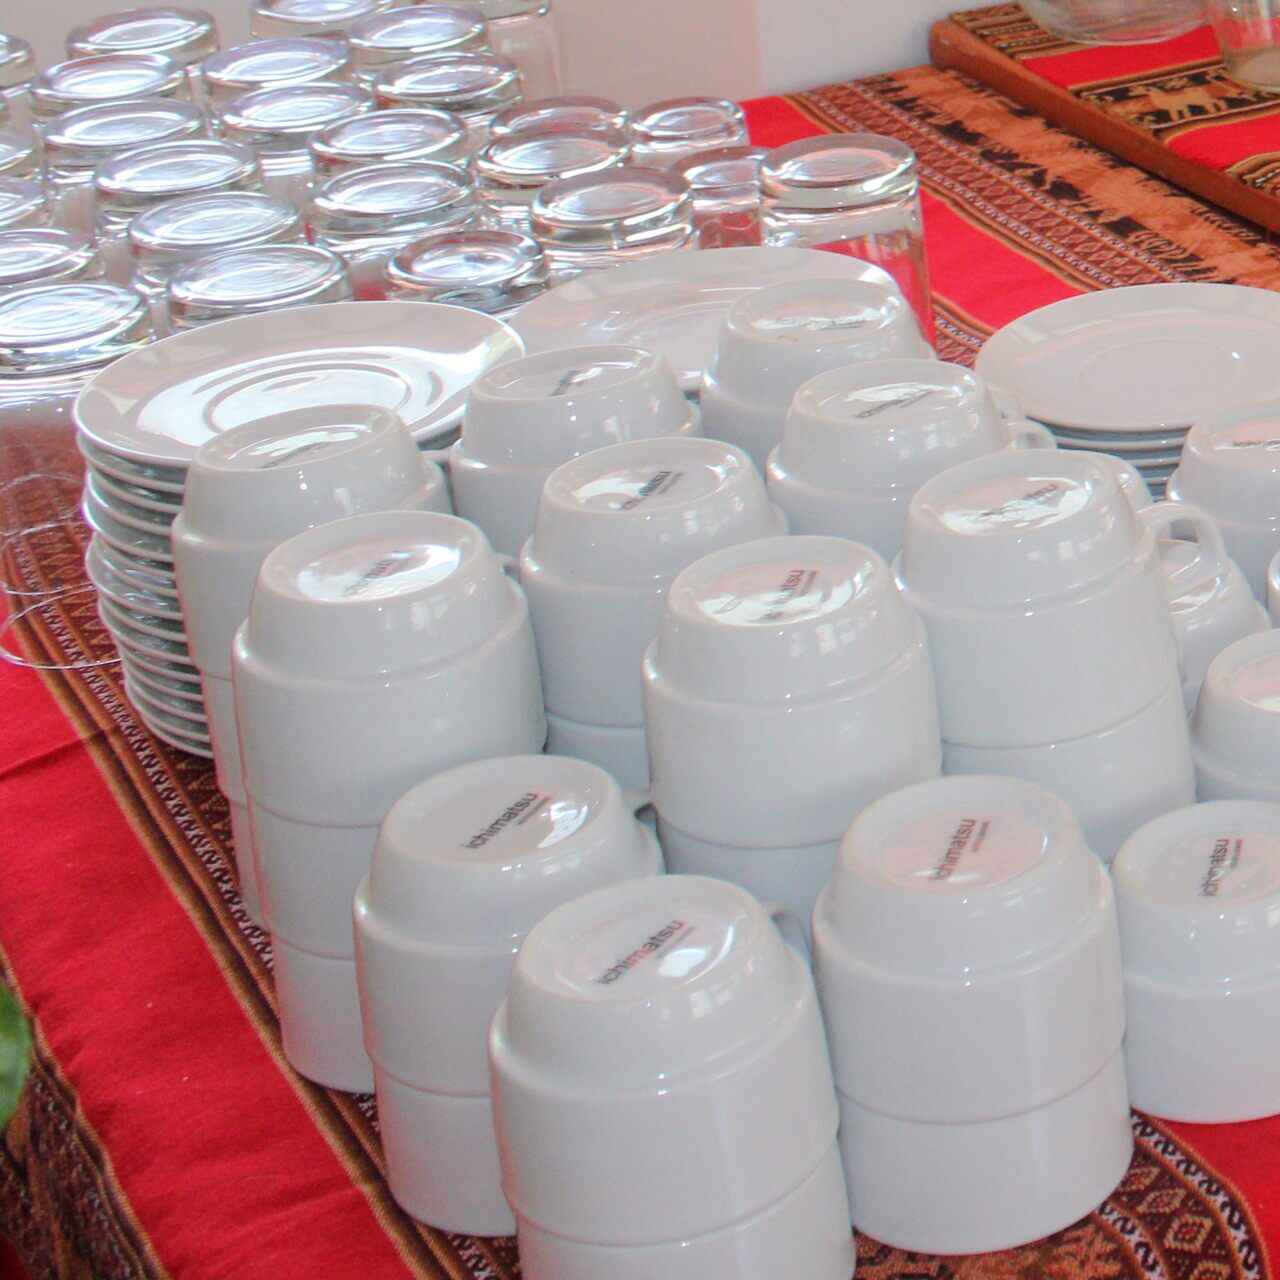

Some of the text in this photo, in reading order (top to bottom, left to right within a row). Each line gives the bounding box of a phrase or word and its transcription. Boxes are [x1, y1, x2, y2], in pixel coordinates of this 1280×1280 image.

[459, 792, 539, 849] ichimatsu
[926, 818, 977, 881] ichimatsu
[592, 919, 687, 985] ichimatsu
